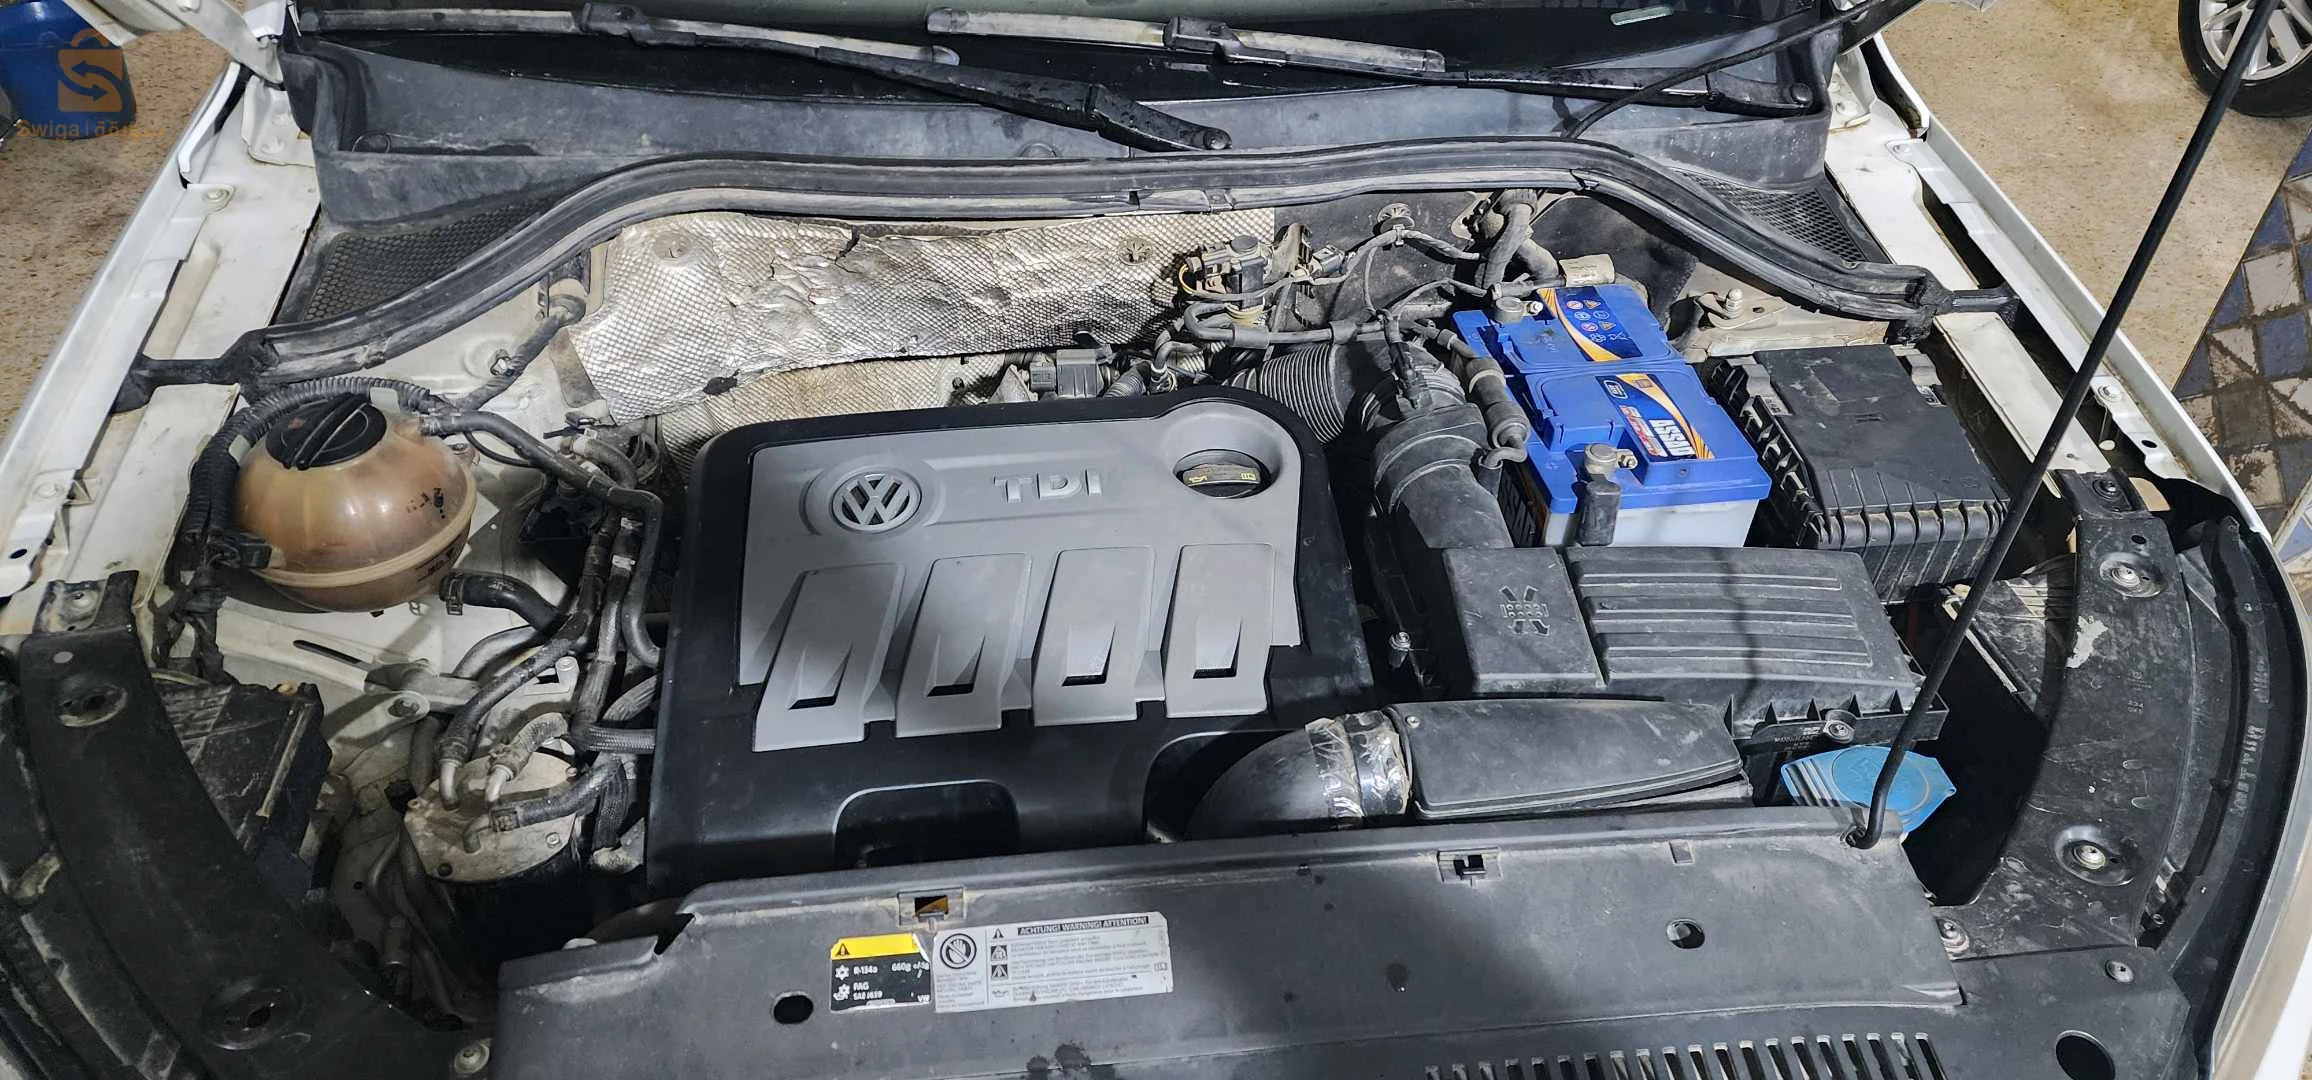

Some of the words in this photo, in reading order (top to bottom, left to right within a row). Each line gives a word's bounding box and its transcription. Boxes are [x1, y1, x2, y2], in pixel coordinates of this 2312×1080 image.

[993, 468, 1102, 503] TDI
[1061, 920, 1103, 932] WARNING!
[1103, 916, 1147, 928] ATTENTION!
